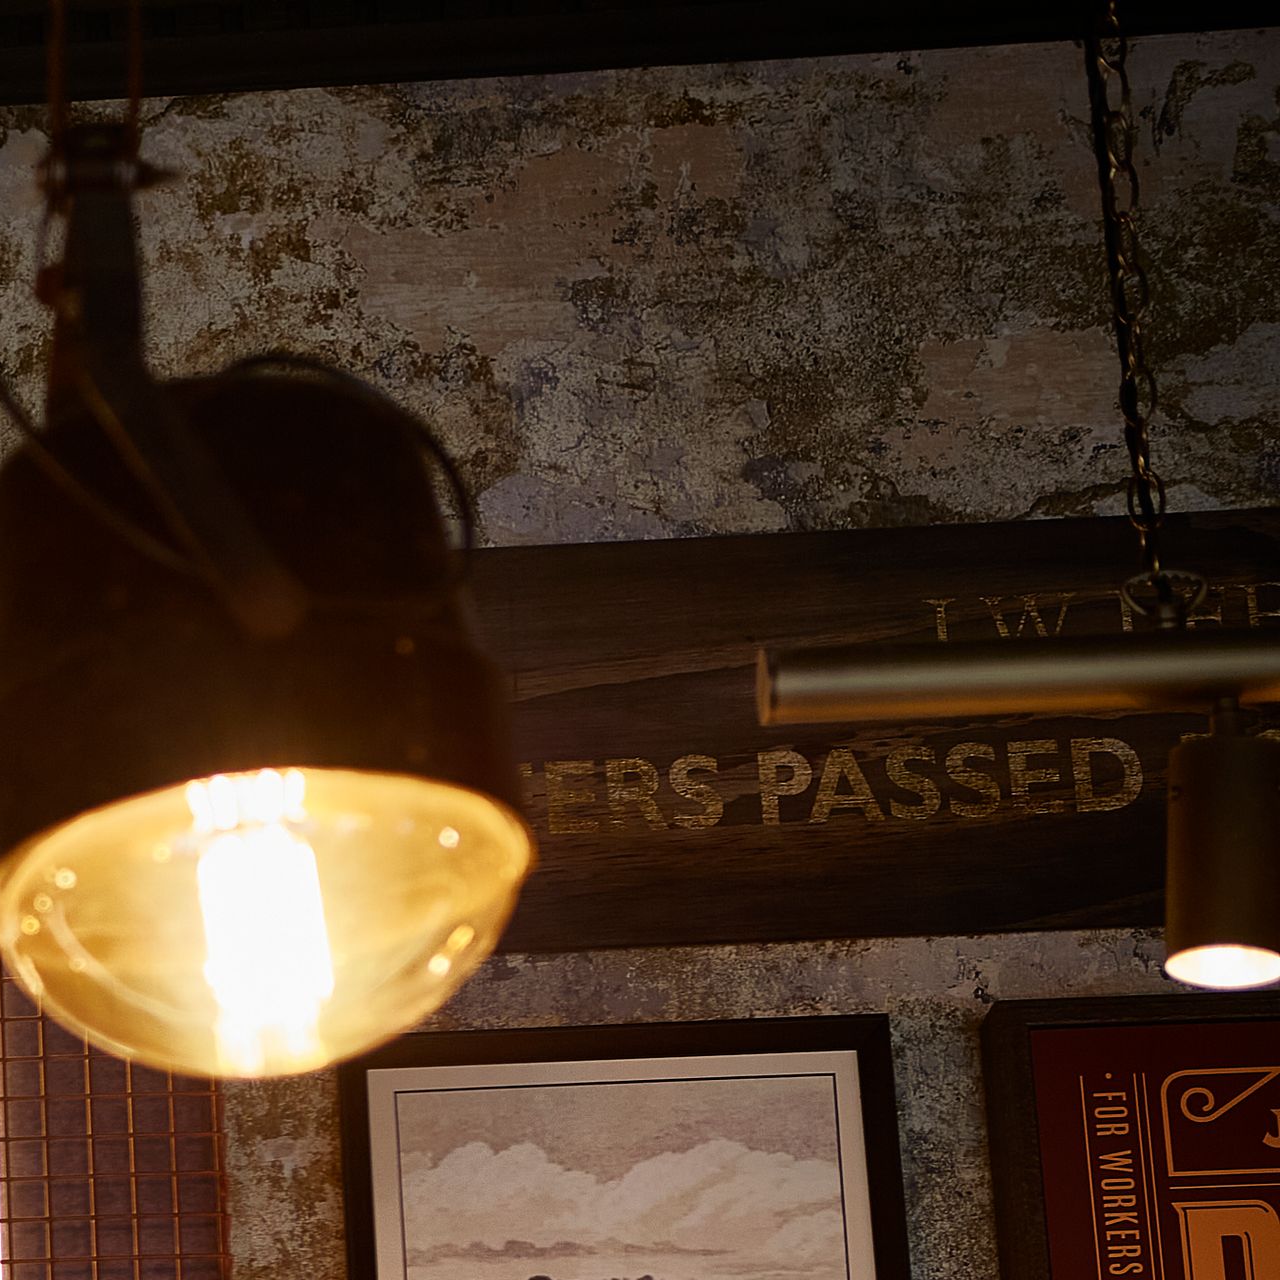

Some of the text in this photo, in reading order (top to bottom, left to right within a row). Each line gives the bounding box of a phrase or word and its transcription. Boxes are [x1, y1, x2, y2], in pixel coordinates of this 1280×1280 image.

[520, 736, 1144, 834] ERS PASSED
[1092, 1090, 1128, 1137] FOR
[1098, 1151, 1145, 1276] WORKERS
